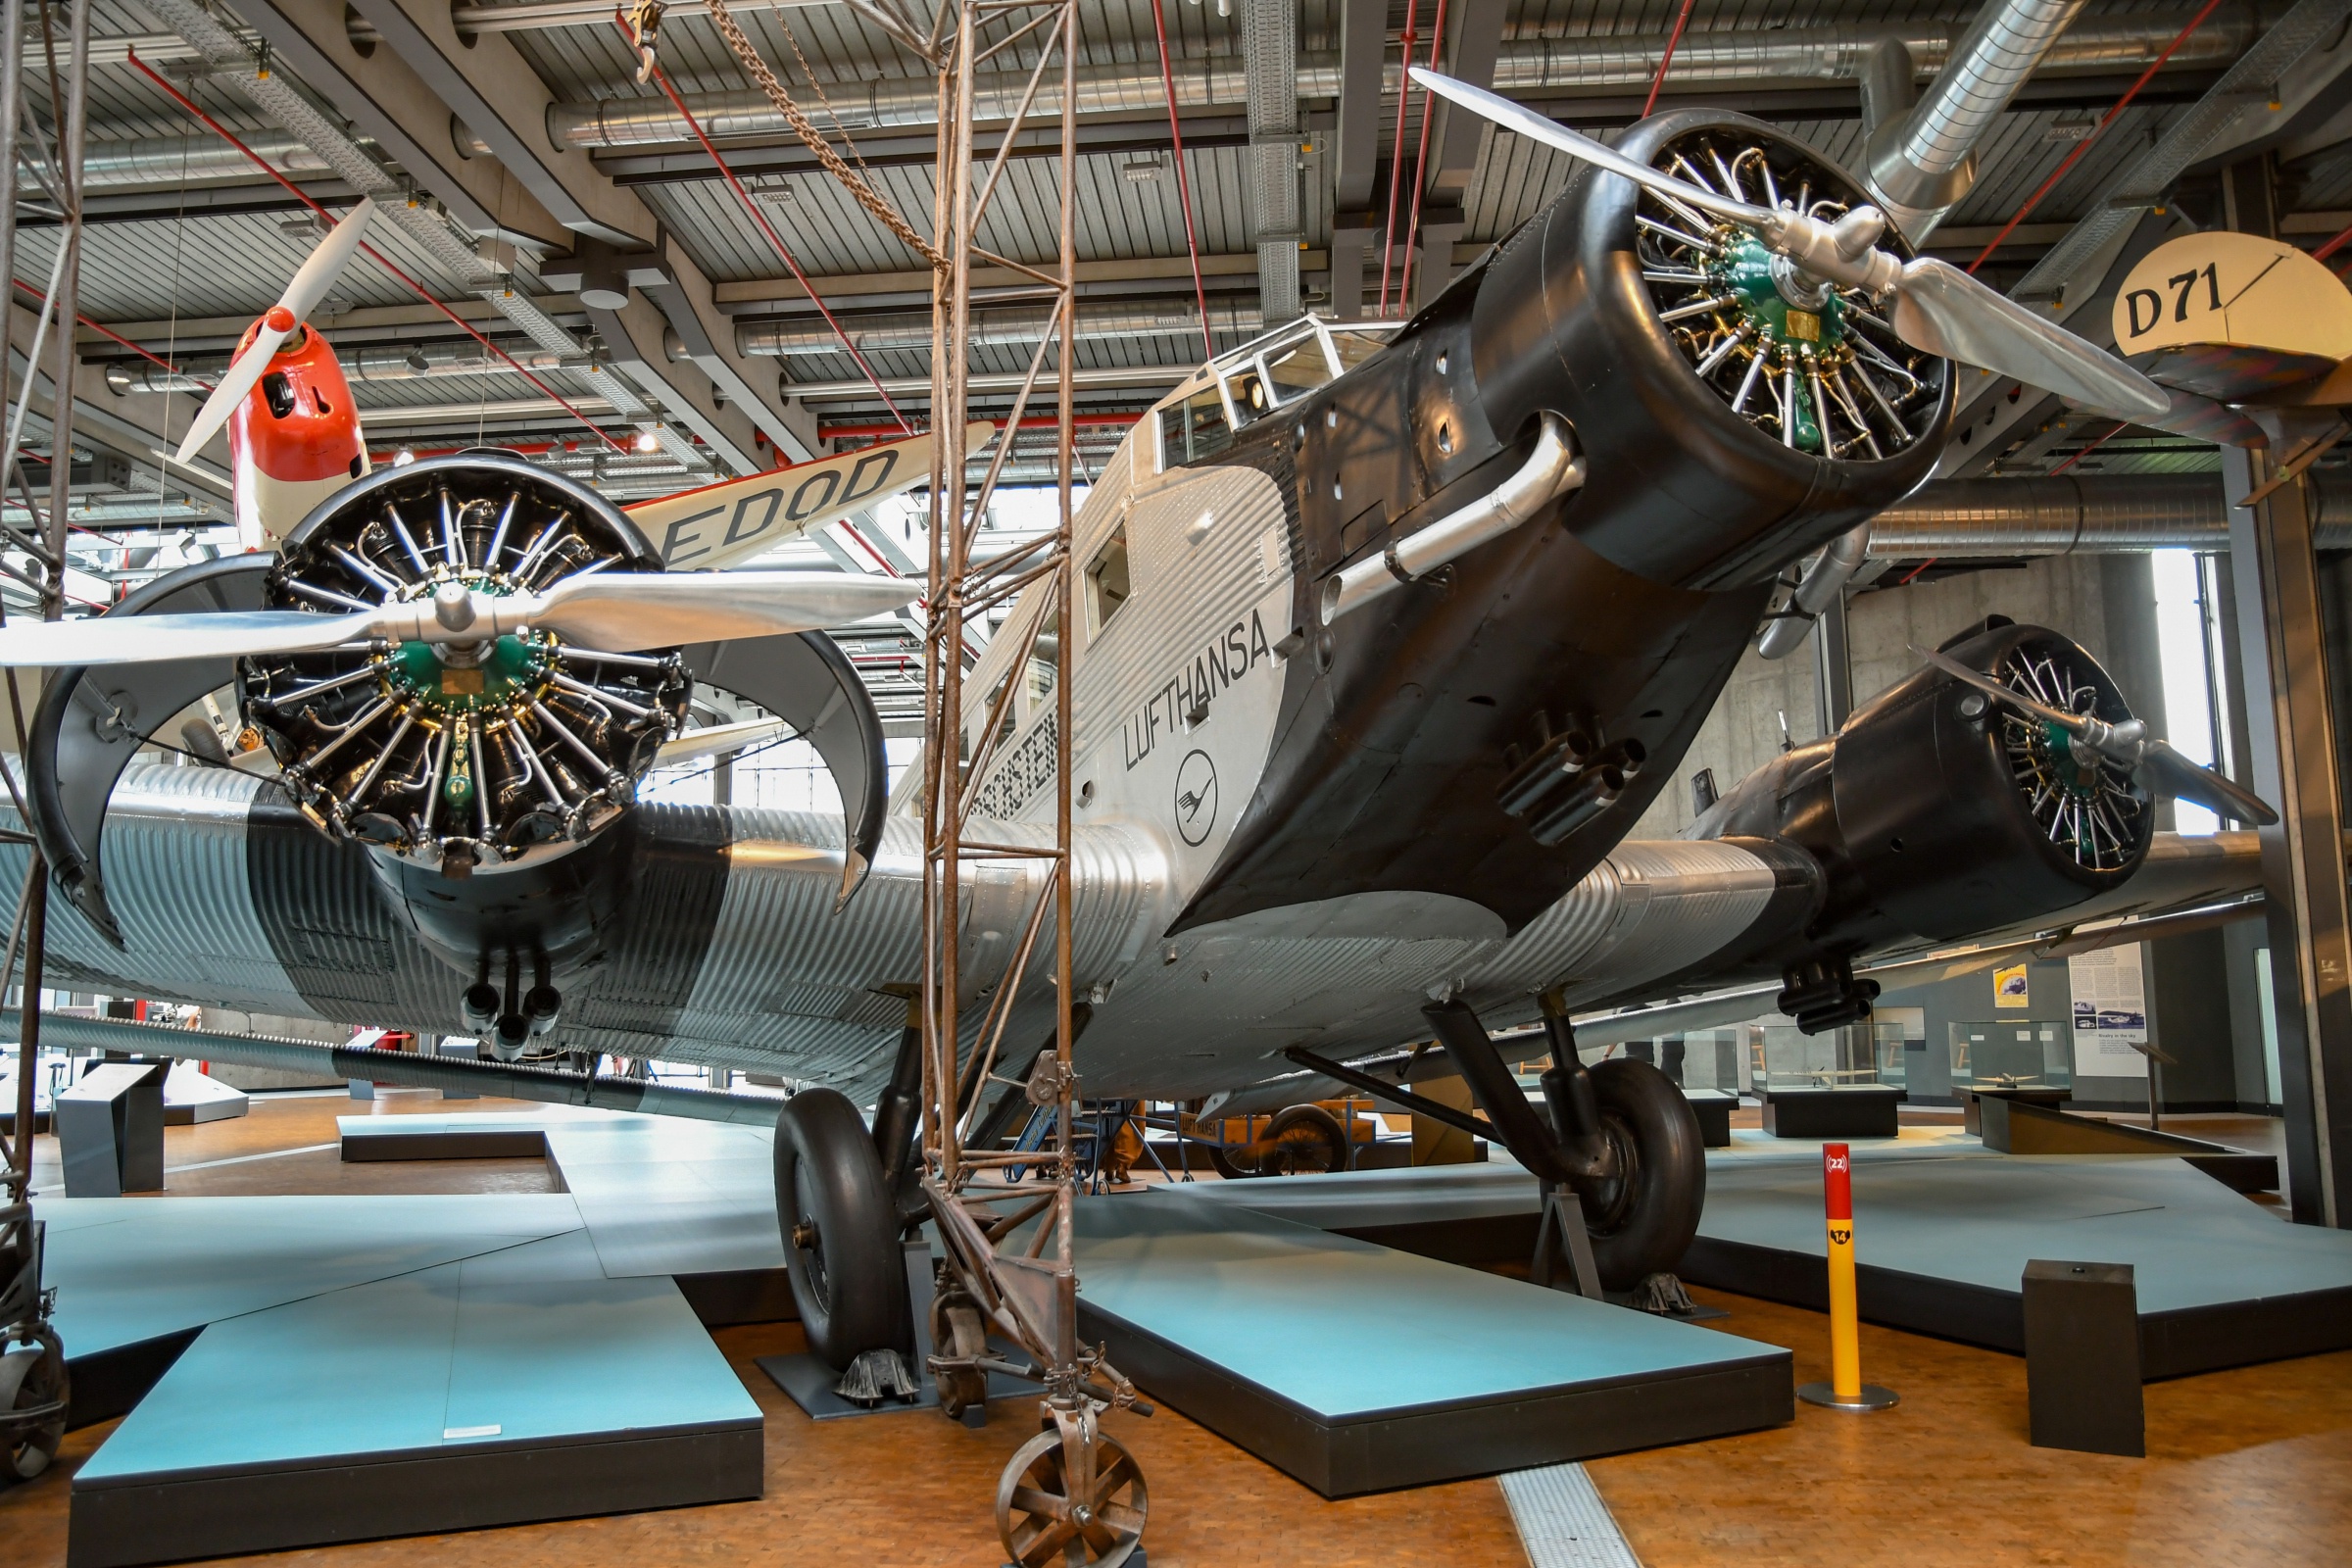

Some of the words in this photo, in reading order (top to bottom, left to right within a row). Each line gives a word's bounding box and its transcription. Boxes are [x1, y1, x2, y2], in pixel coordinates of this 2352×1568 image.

[1123, 608, 1271, 772] LUFTHANSA
[1831, 1158, 1843, 1169] 22
[1834, 1232, 1846, 1243] 14
